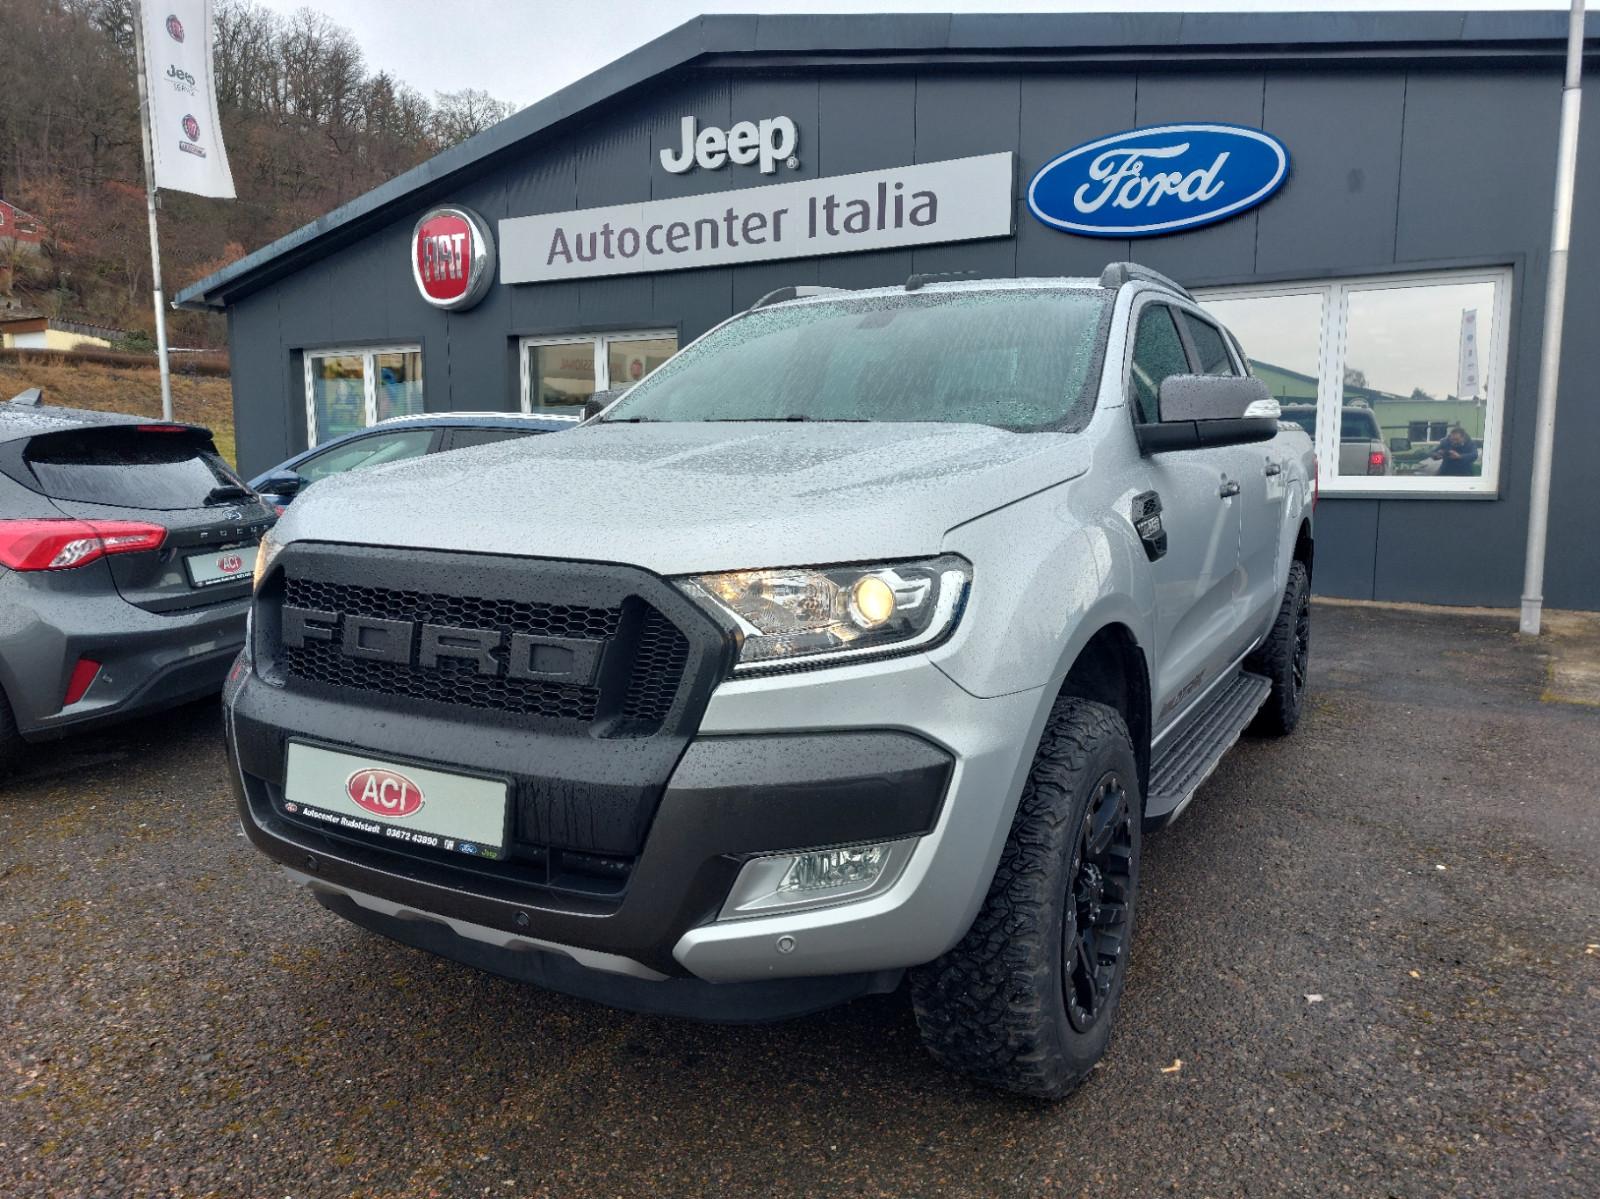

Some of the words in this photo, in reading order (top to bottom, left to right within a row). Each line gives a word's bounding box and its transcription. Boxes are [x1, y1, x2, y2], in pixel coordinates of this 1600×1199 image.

[660, 116, 799, 174] Jeep
[1074, 142, 1230, 213] Ford
[546, 208, 789, 266] Autocenter
[808, 182, 938, 239] Italia
[423, 233, 465, 282] FIAT
[282, 604, 608, 686] FORD
[302, 807, 340, 823] Autocenter
[361, 774, 407, 811] ACI
